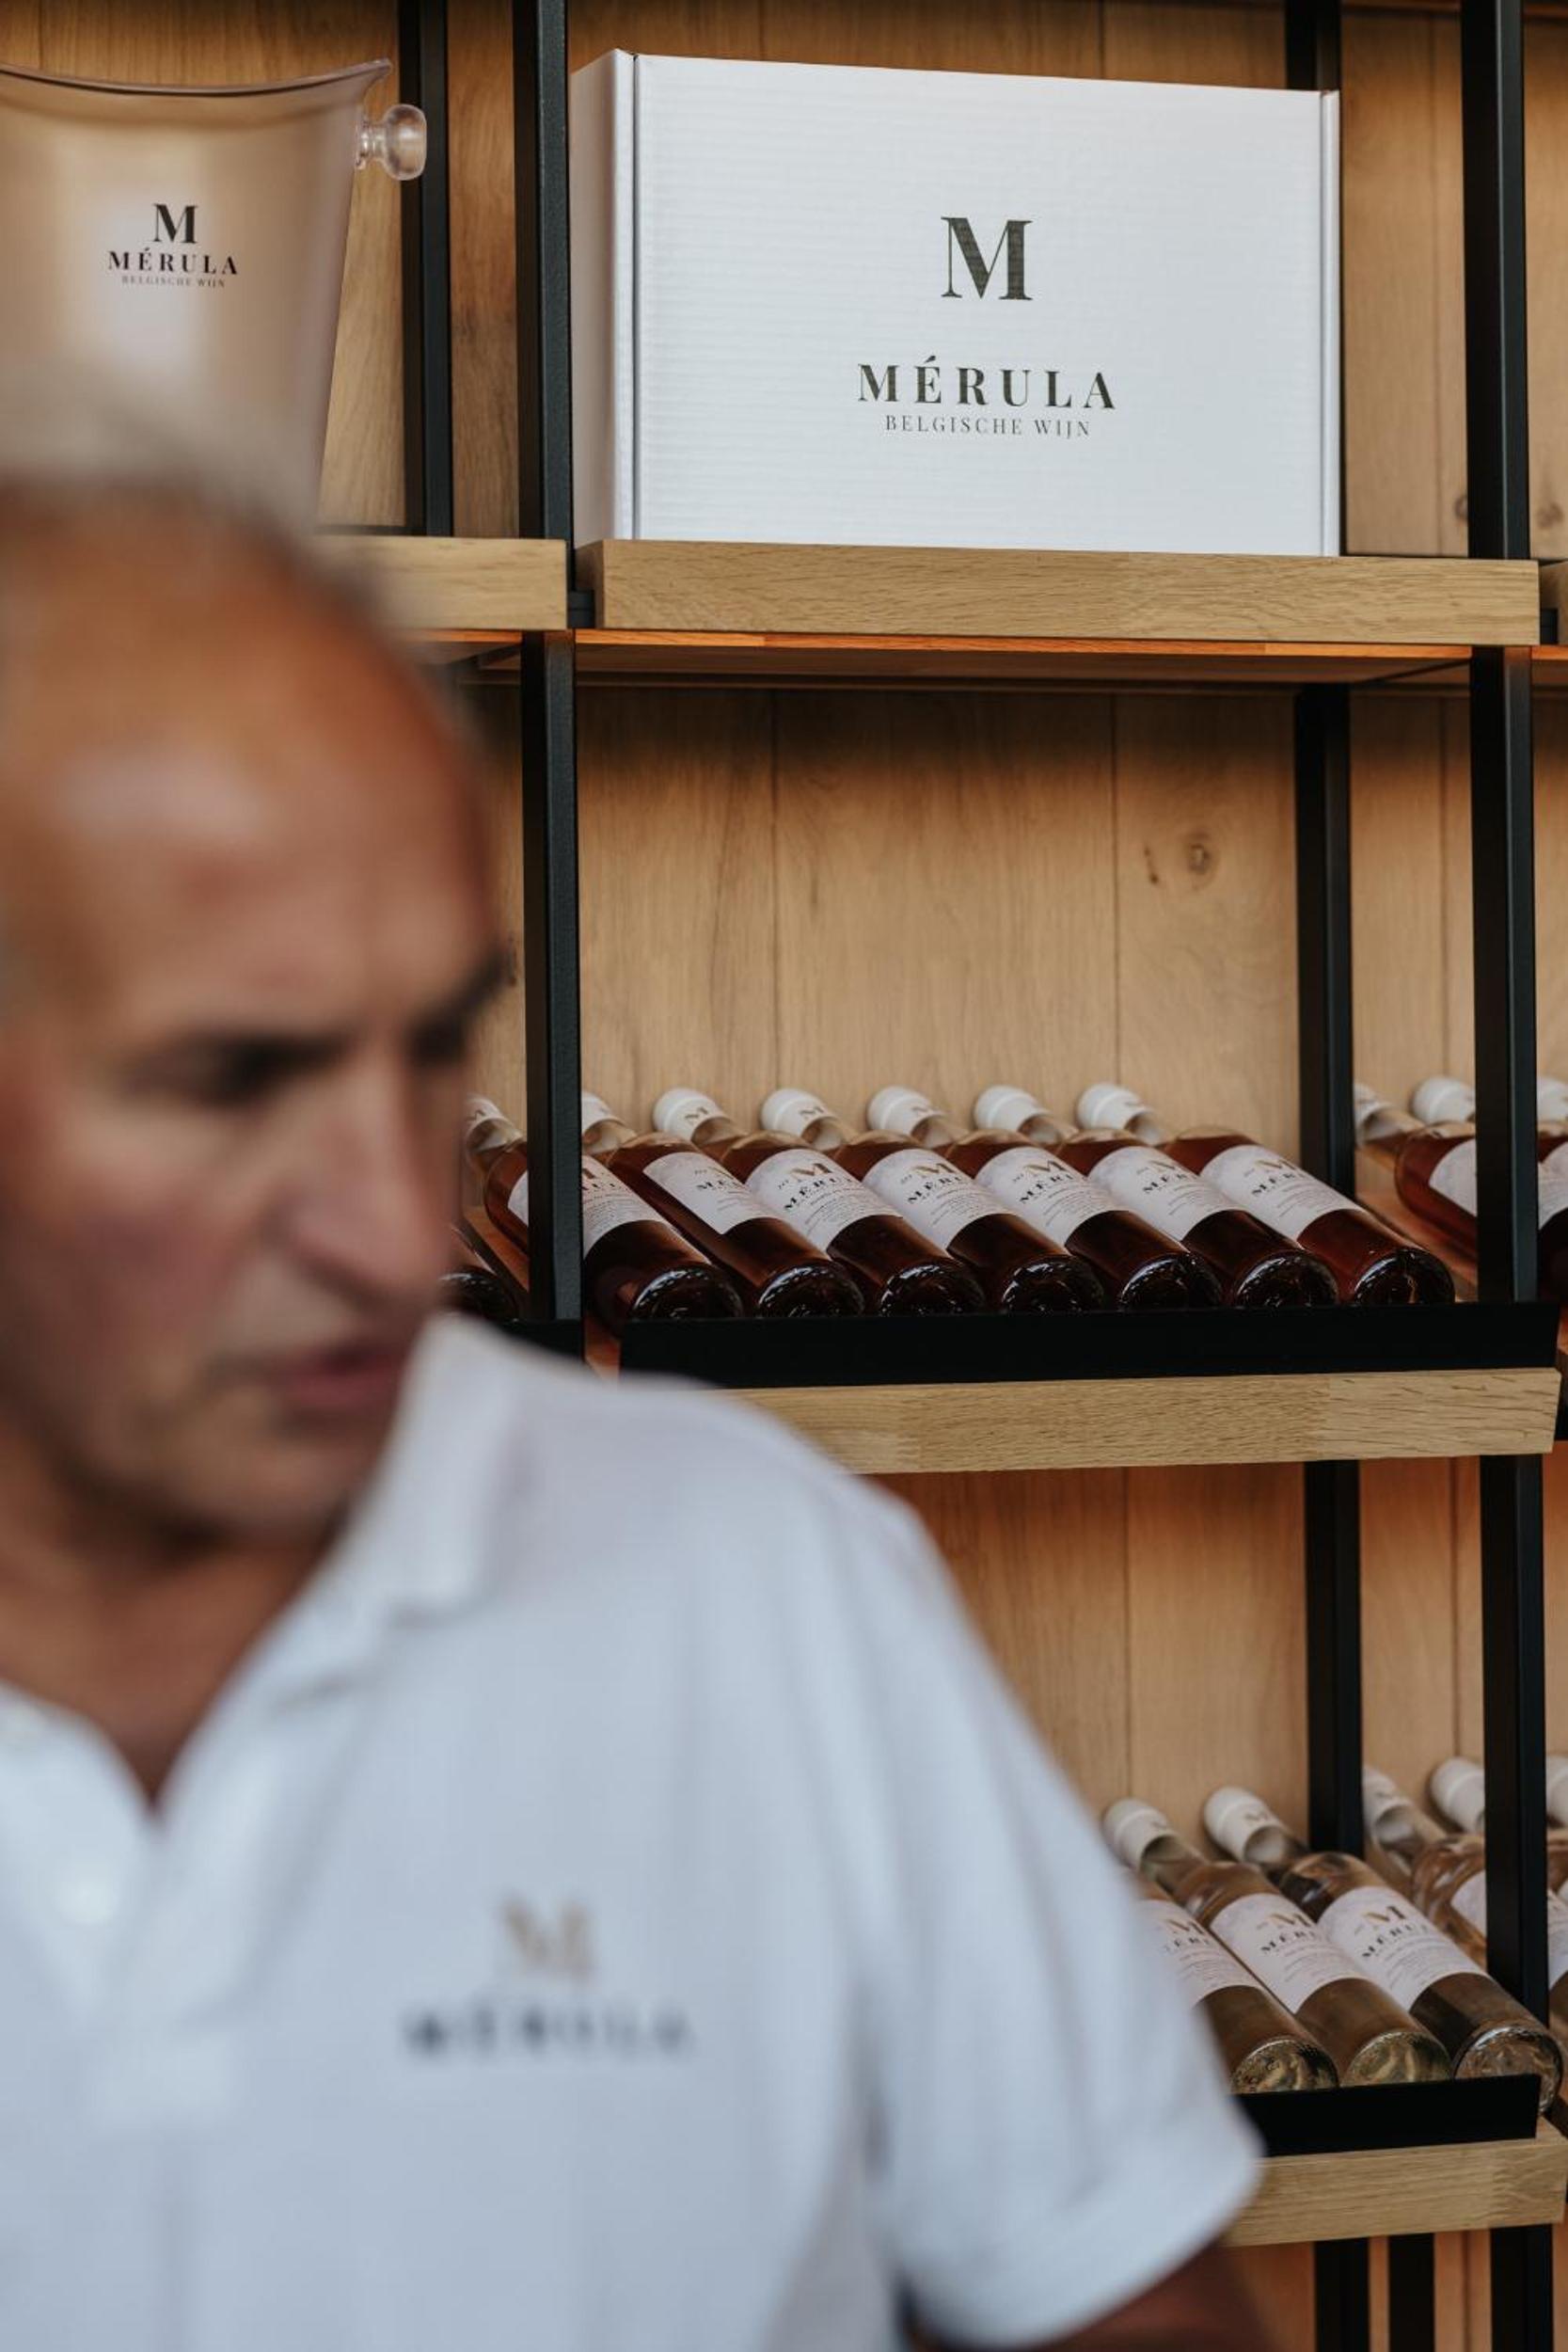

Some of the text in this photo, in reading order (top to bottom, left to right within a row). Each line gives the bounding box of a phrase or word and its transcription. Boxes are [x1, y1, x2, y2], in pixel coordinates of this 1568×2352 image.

[153, 203, 198, 244] M
[108, 247, 237, 275] MÉRULA
[941, 216, 1033, 300] M
[858, 356, 1116, 410] MÉRULA
[886, 415, 1090, 439] BELGISCHE WIJN
